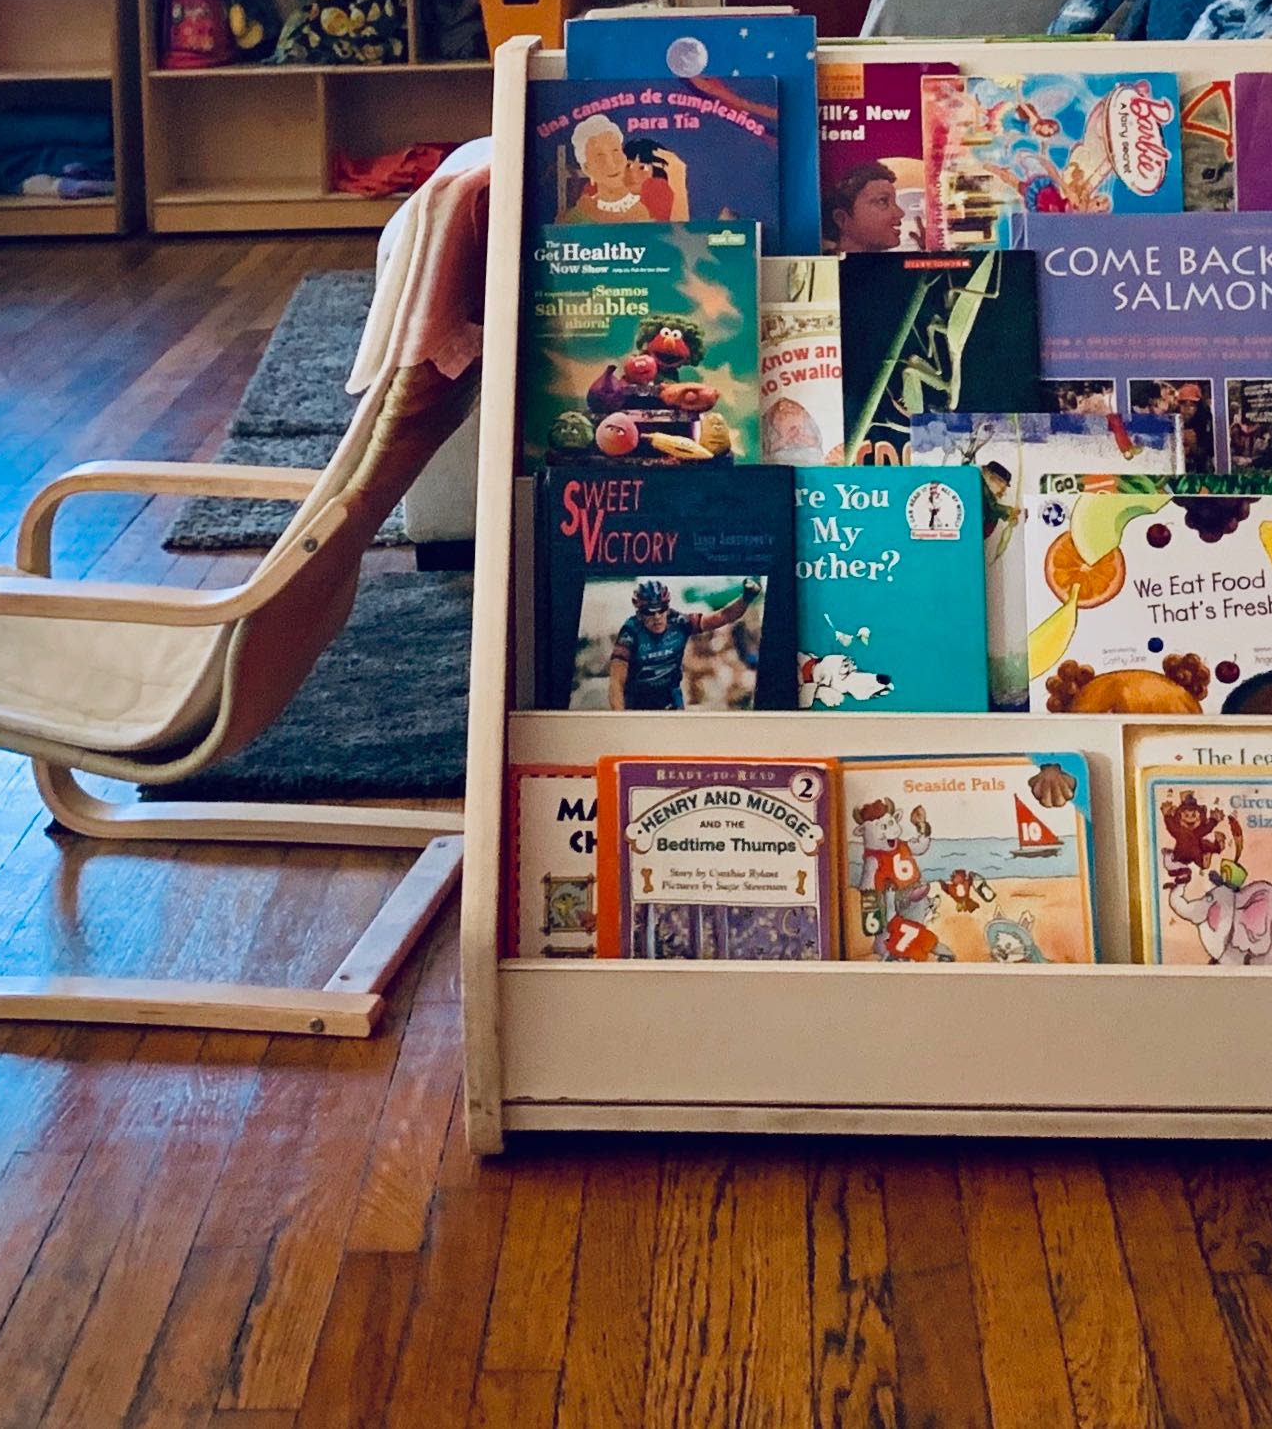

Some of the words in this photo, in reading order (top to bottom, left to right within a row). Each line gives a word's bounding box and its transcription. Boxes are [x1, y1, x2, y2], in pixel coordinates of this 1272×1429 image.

[536, 114, 570, 140] Una
[571, 90, 635, 121] canasta
[639, 88, 663, 105] de
[666, 90, 767, 138] cumpleaños
[627, 114, 669, 133] para
[673, 112, 701, 130] Tía
[818, 104, 859, 123] ill's
[865, 105, 912, 122] New
[821, 125, 866, 142] iend
[1130, 95, 1173, 182] Barbie
[534, 248, 561, 262] Get
[563, 242, 647, 265] Healthy
[1043, 245, 1162, 277] COME
[534, 297, 650, 317] saludables
[814, 344, 838, 360] an
[780, 361, 842, 388] Swallo
[560, 479, 645, 537] SWEET
[795, 486, 826, 509] re
[833, 483, 890, 510] You
[579, 508, 679, 564] VICTORY
[810, 515, 865, 552] My
[795, 549, 901, 583] other?
[1134, 578, 1163, 599] We
[1169, 575, 1205, 595] Eat
[1212, 569, 1267, 593] Food
[1147, 599, 1217, 624] That's
[1192, 747, 1233, 767] The
[796, 777, 814, 799] 2
[903, 778, 967, 794] Seaside
[970, 777, 1007, 791] Pals
[641, 790, 699, 834] HENRY
[704, 790, 743, 807] AND
[745, 791, 812, 839] MUDGE
[699, 819, 723, 830] AND
[725, 820, 746, 830] THE
[1021, 822, 1043, 842] 10
[656, 837, 727, 852] Bedtime
[729, 837, 798, 856] Thumps
[669, 868, 695, 880] Story
[695, 868, 708, 880] by
[892, 853, 915, 882] 6
[701, 881, 714, 893] by
[865, 912, 880, 933] 6
[895, 922, 921, 953] 7
